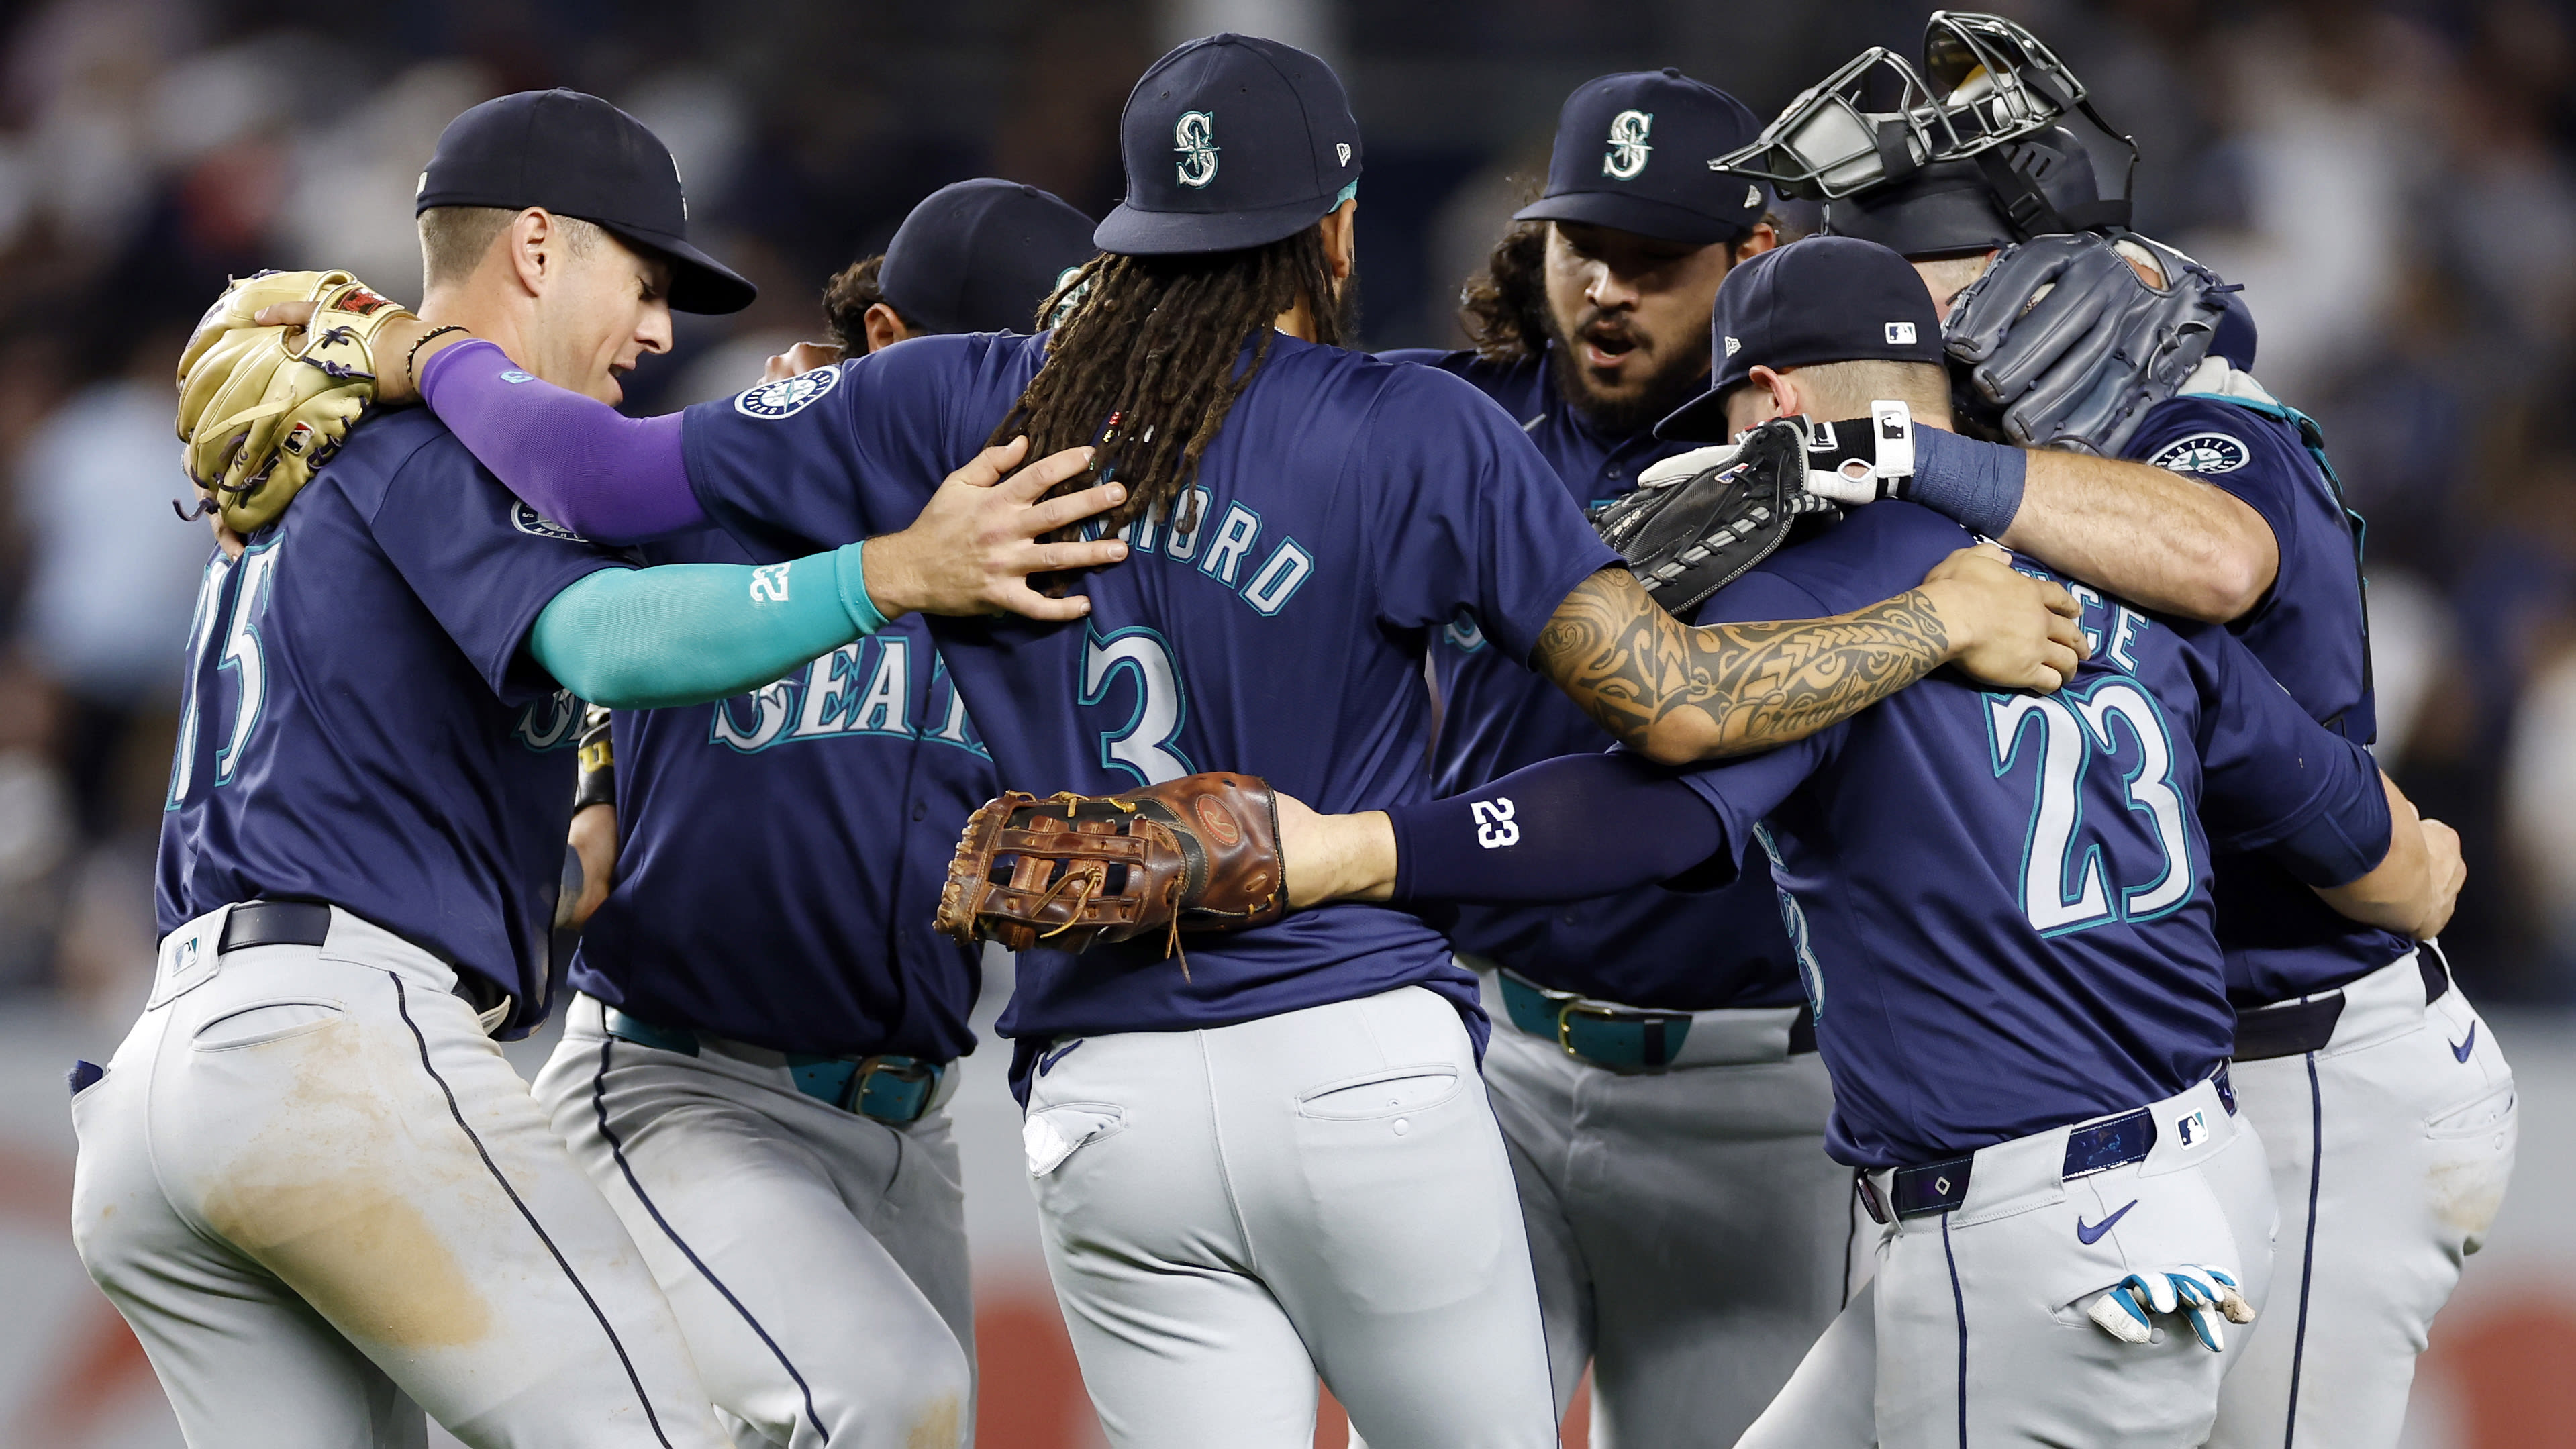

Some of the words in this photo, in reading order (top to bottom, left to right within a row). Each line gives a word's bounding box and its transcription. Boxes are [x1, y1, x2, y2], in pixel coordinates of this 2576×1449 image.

[2155, 438, 2234, 466] SEATTLE
[1078, 617, 1197, 787] 3
[1470, 797, 1520, 849] 23
[1981, 675, 2195, 938] 23
